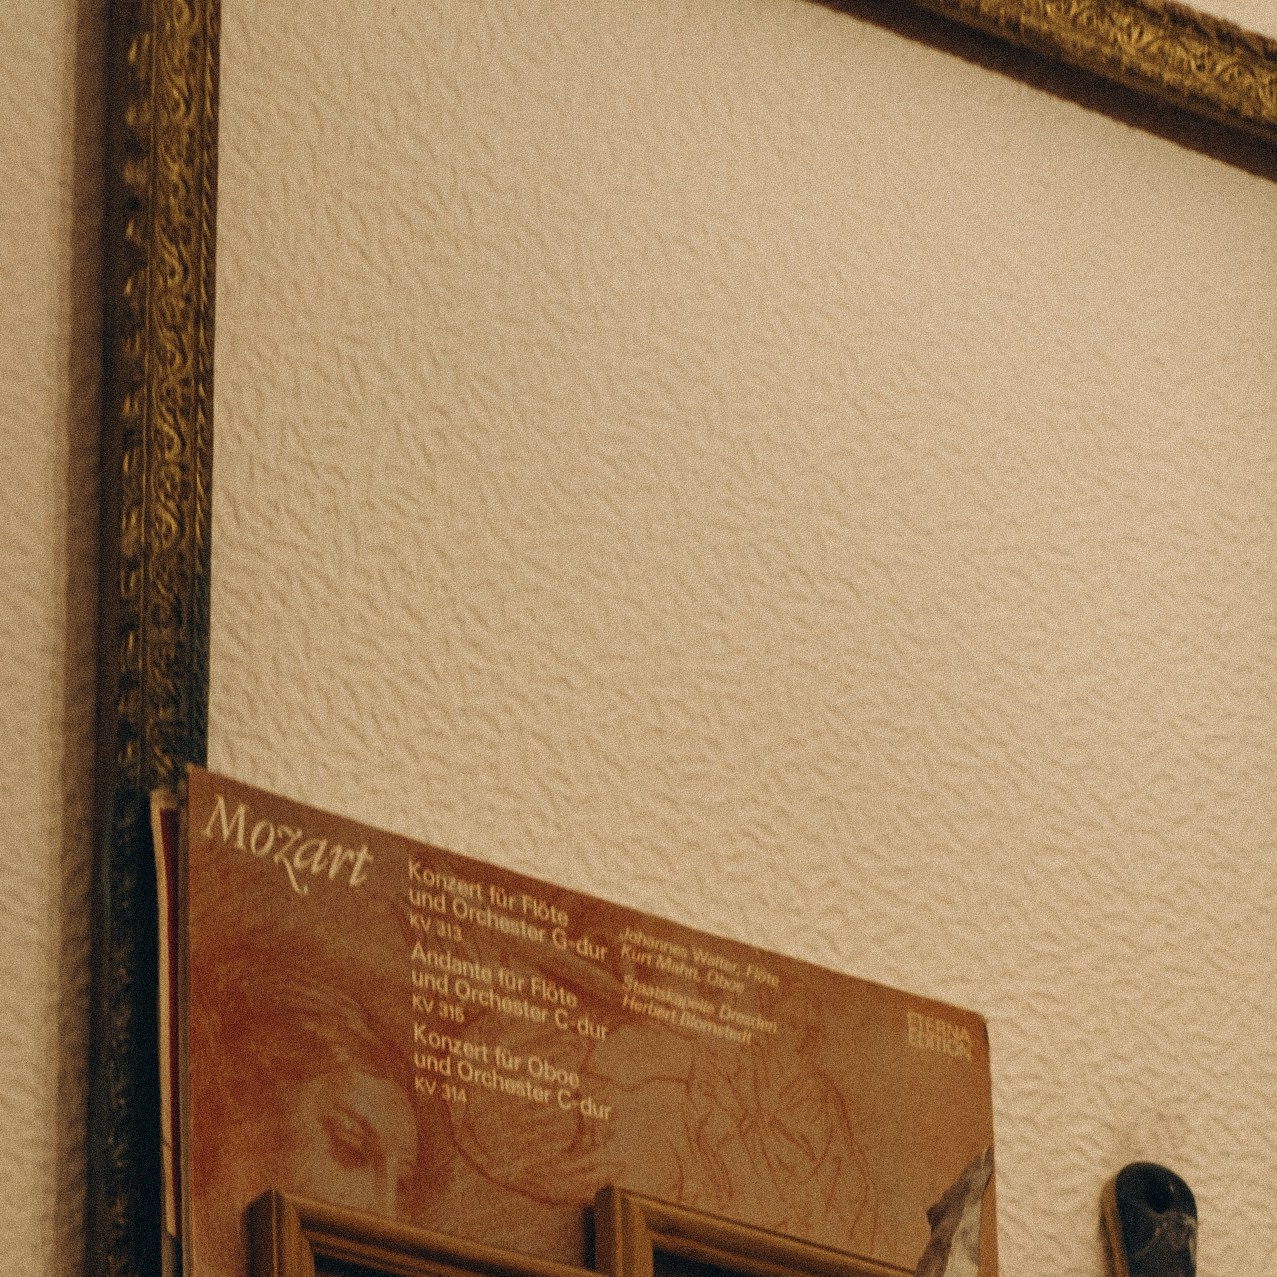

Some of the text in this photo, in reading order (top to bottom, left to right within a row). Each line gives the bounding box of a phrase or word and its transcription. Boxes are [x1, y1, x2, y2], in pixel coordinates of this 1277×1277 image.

[201, 795, 373, 897] Mozart
[408, 859, 569, 928] Konzert für Flöte
[409, 889, 608, 961] und Orchester G-dur
[409, 912, 462, 942] KV 313
[619, 927, 688, 958] Johannes
[411, 942, 578, 1009] Andante für Flöte
[621, 945, 652, 966] Kurt
[707, 970, 745, 994] Oboe
[412, 995, 434, 1014] KV
[412, 970, 609, 1041] und Orchester C-dur
[623, 975, 778, 1034] Staatskapelle Dresden
[623, 995, 752, 1045] Herbert Blomstedt
[907, 1011, 971, 1045] ETERNA
[414, 1023, 580, 1090] Konzert für Oboe
[908, 1027, 971, 1061] EDITION
[414, 1053, 613, 1121] und Orchester C-dur
[415, 1077, 467, 1104] KV 314
